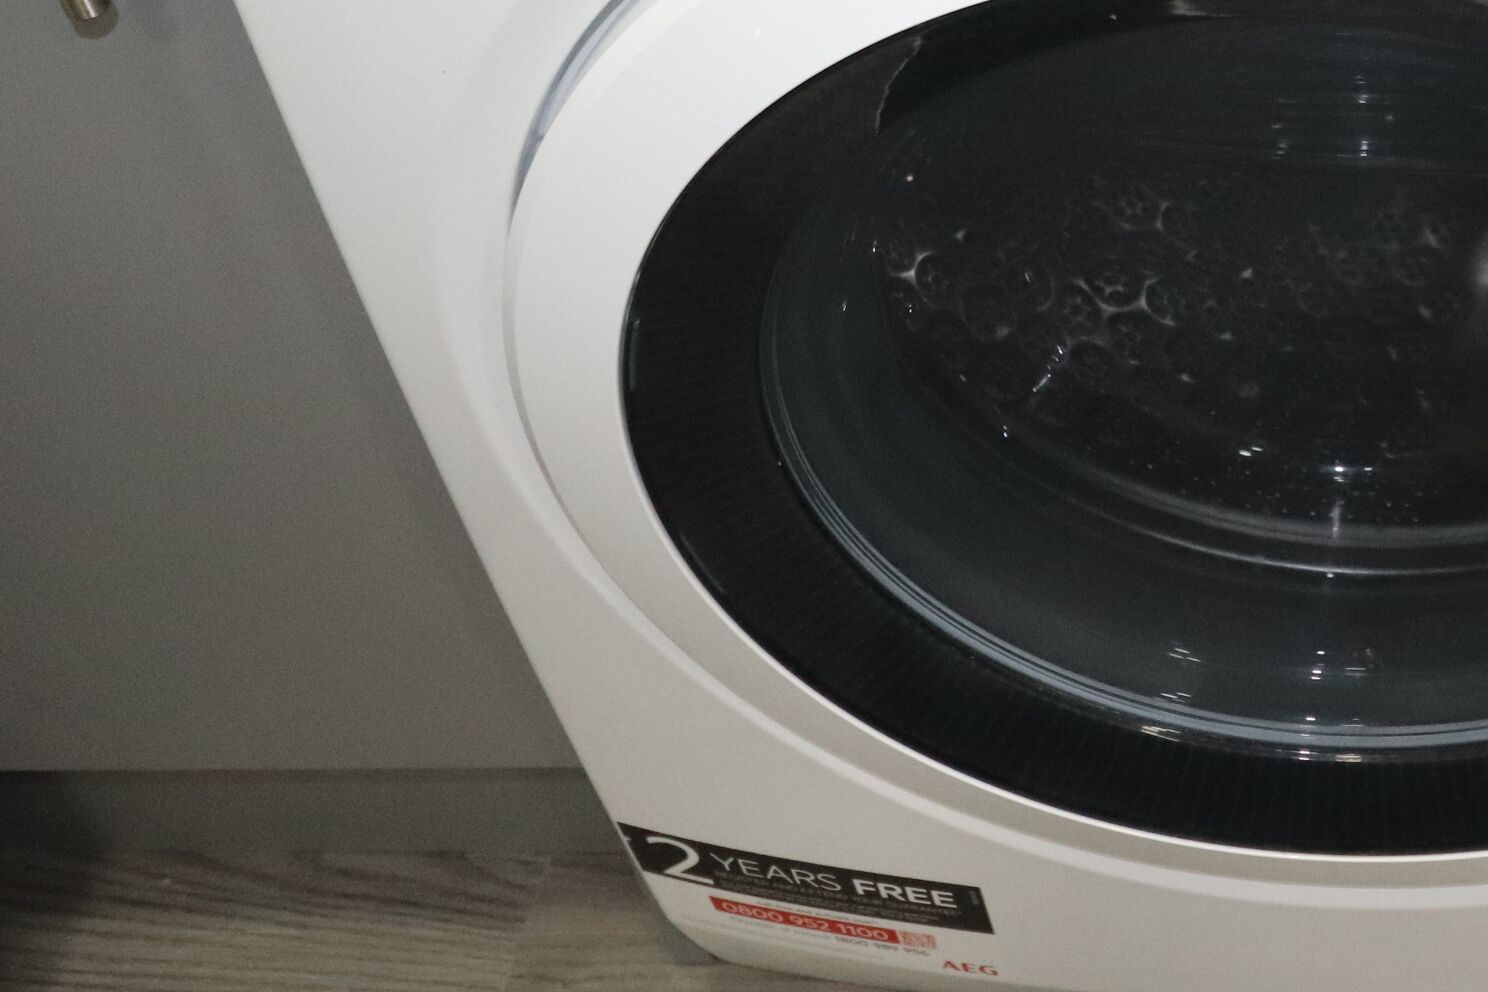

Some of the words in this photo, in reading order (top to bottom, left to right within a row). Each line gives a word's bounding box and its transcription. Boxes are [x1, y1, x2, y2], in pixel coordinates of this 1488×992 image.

[709, 851, 842, 892] YEARS
[852, 878, 958, 909] FREE
[722, 901, 783, 925] 0800
[836, 922, 890, 943] 1100
[942, 959, 999, 977] AEG
